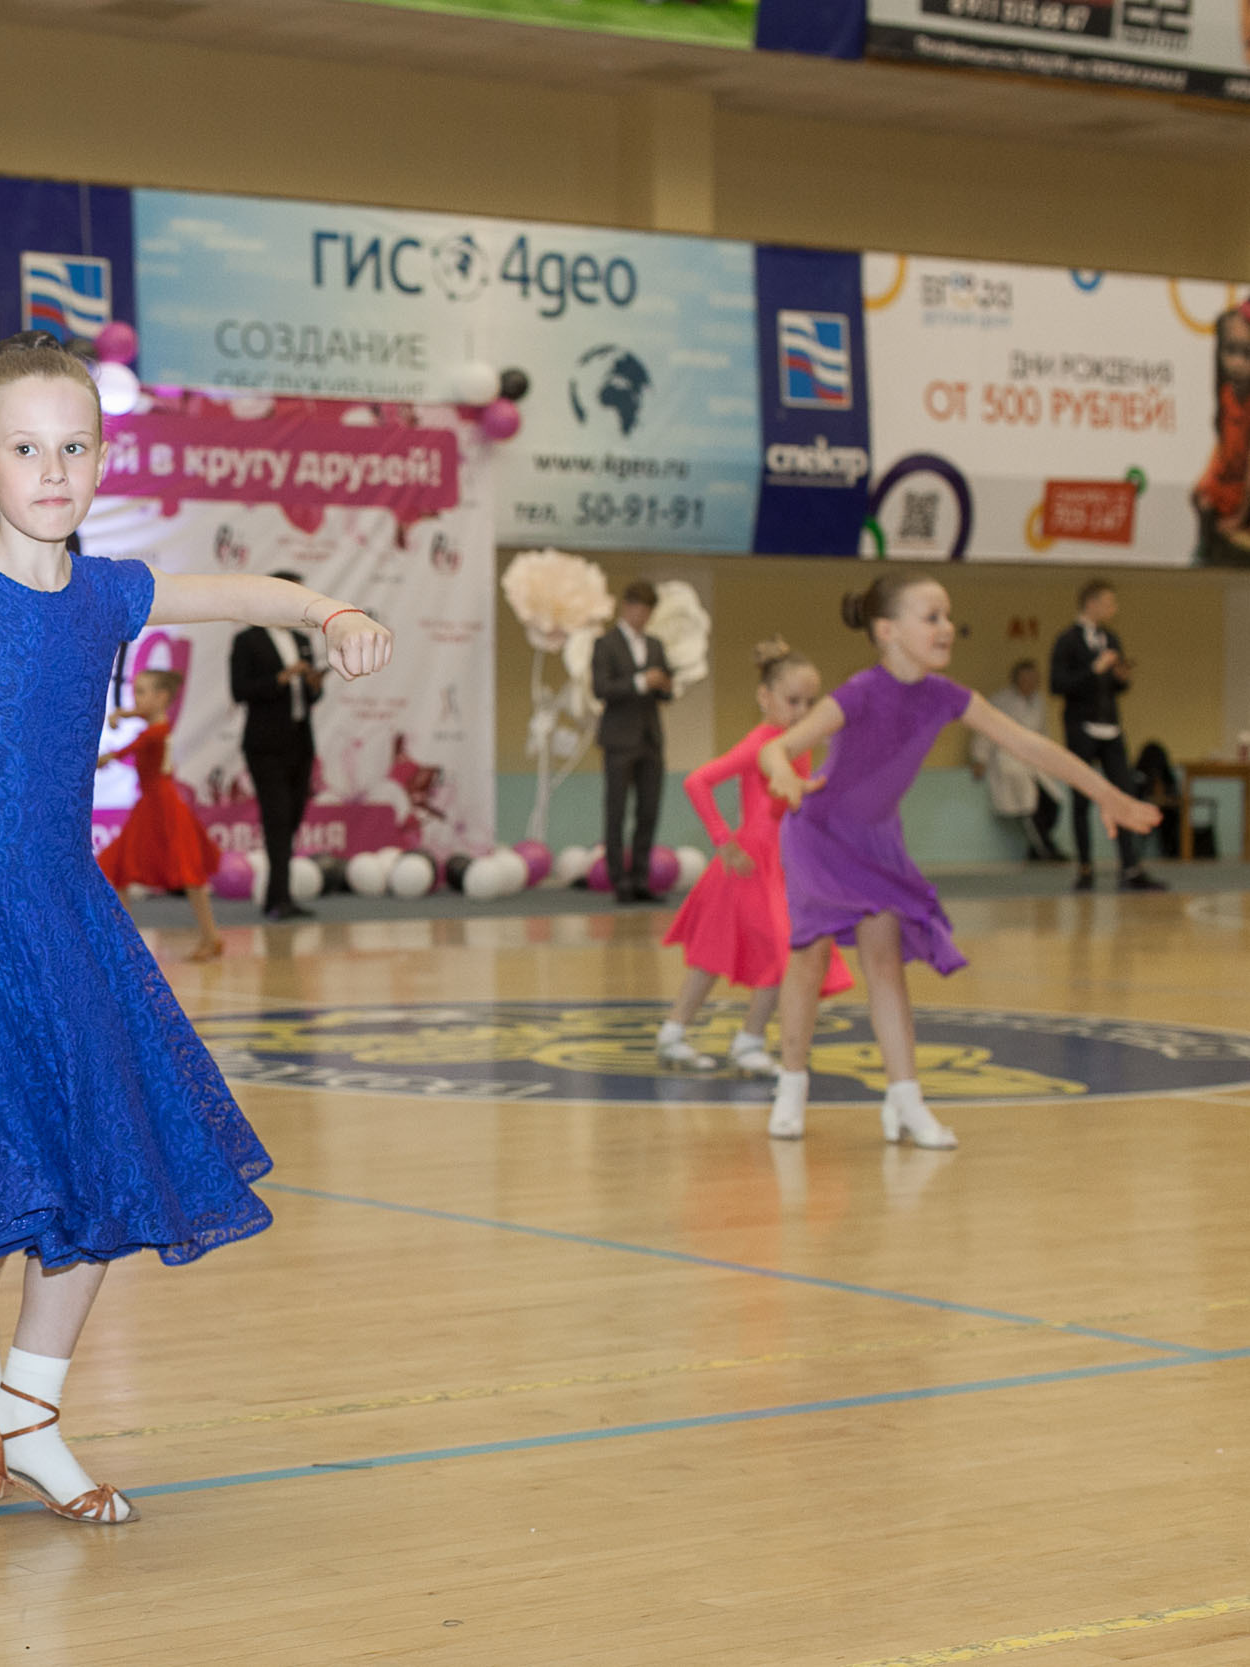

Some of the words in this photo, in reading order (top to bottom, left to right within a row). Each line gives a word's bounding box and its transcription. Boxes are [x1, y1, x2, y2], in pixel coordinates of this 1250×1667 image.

[312, 231, 423, 295] ГИС
[500, 234, 638, 319] 4geo
[214, 318, 428, 371] СОЗДАНИЕ
[1060, 353, 1174, 386] РОЖДЕНИЯ
[923, 379, 967, 423] ОТ
[981, 383, 1043, 428] 500
[150, 443, 174, 476] в
[183, 445, 292, 488] кругу
[295, 447, 443, 492] друзей!
[574, 491, 706, 528] 50-91-91
